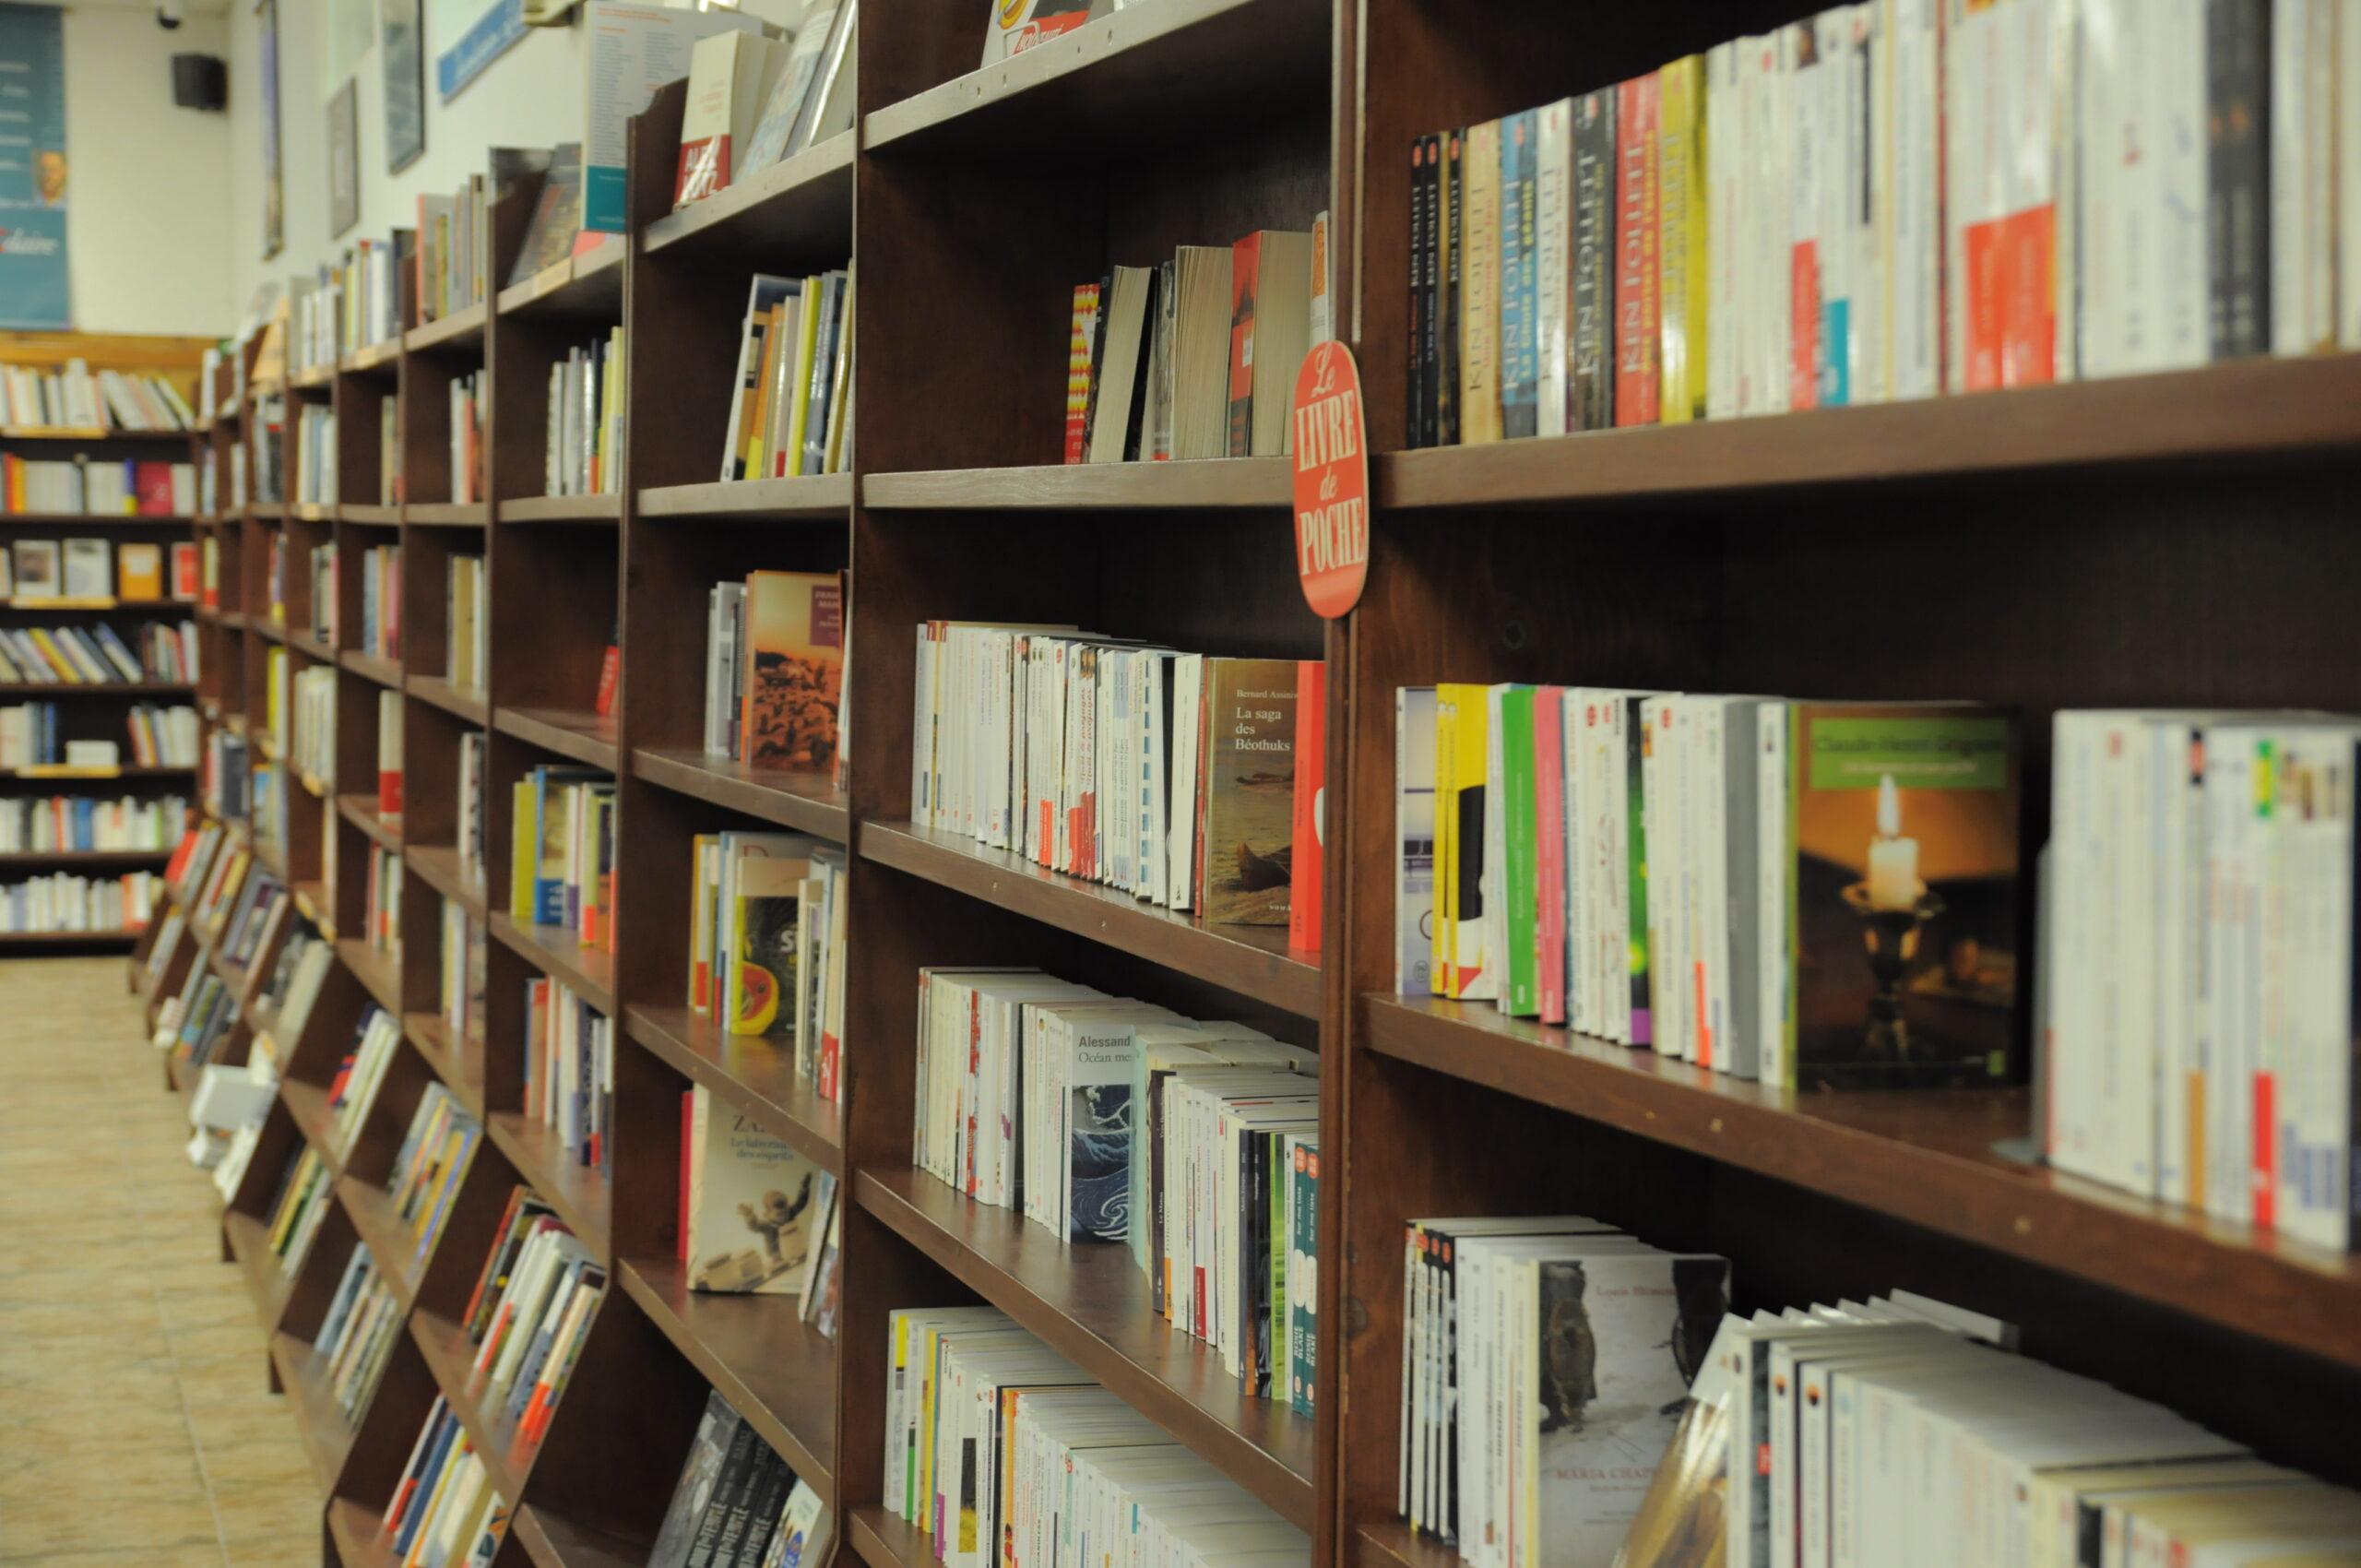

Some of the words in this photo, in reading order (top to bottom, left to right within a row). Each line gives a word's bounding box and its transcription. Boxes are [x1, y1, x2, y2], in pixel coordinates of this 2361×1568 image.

[1519, 180, 1534, 246] géants
[1540, 167, 1555, 306] FOLLETT
[1575, 149, 1596, 292] FOLLETT
[1621, 141, 1643, 288] FOLLETT
[1468, 185, 1485, 313] FOLLETT
[1501, 179, 1521, 313] FOLLETT
[1519, 250, 1532, 287] des
[1519, 292, 1532, 349] Chute
[1577, 305, 1596, 376] KEN
[1621, 300, 1641, 374] KEN
[1311, 342, 1336, 398] Le
[1468, 328, 1484, 391] KEN
[1502, 323, 1520, 391] KEN
[1519, 354, 1531, 379] La
[1296, 389, 1357, 472] LIVRE
[1320, 465, 1337, 501] de
[1299, 496, 1364, 576] POCHE
[1236, 689, 1267, 698] Bernard
[1236, 707, 1252, 719] La
[1255, 708, 1282, 722] saga
[1235, 722, 1255, 735] des
[1235, 738, 1291, 752] Béothuks
[1078, 1035, 1131, 1048] Alessand
[1078, 1051, 1111, 1063] Océan
[1296, 1206, 1302, 1220] ma
[1309, 1212, 1315, 1227] ma
[1557, 1467, 1606, 1480] MARIA
